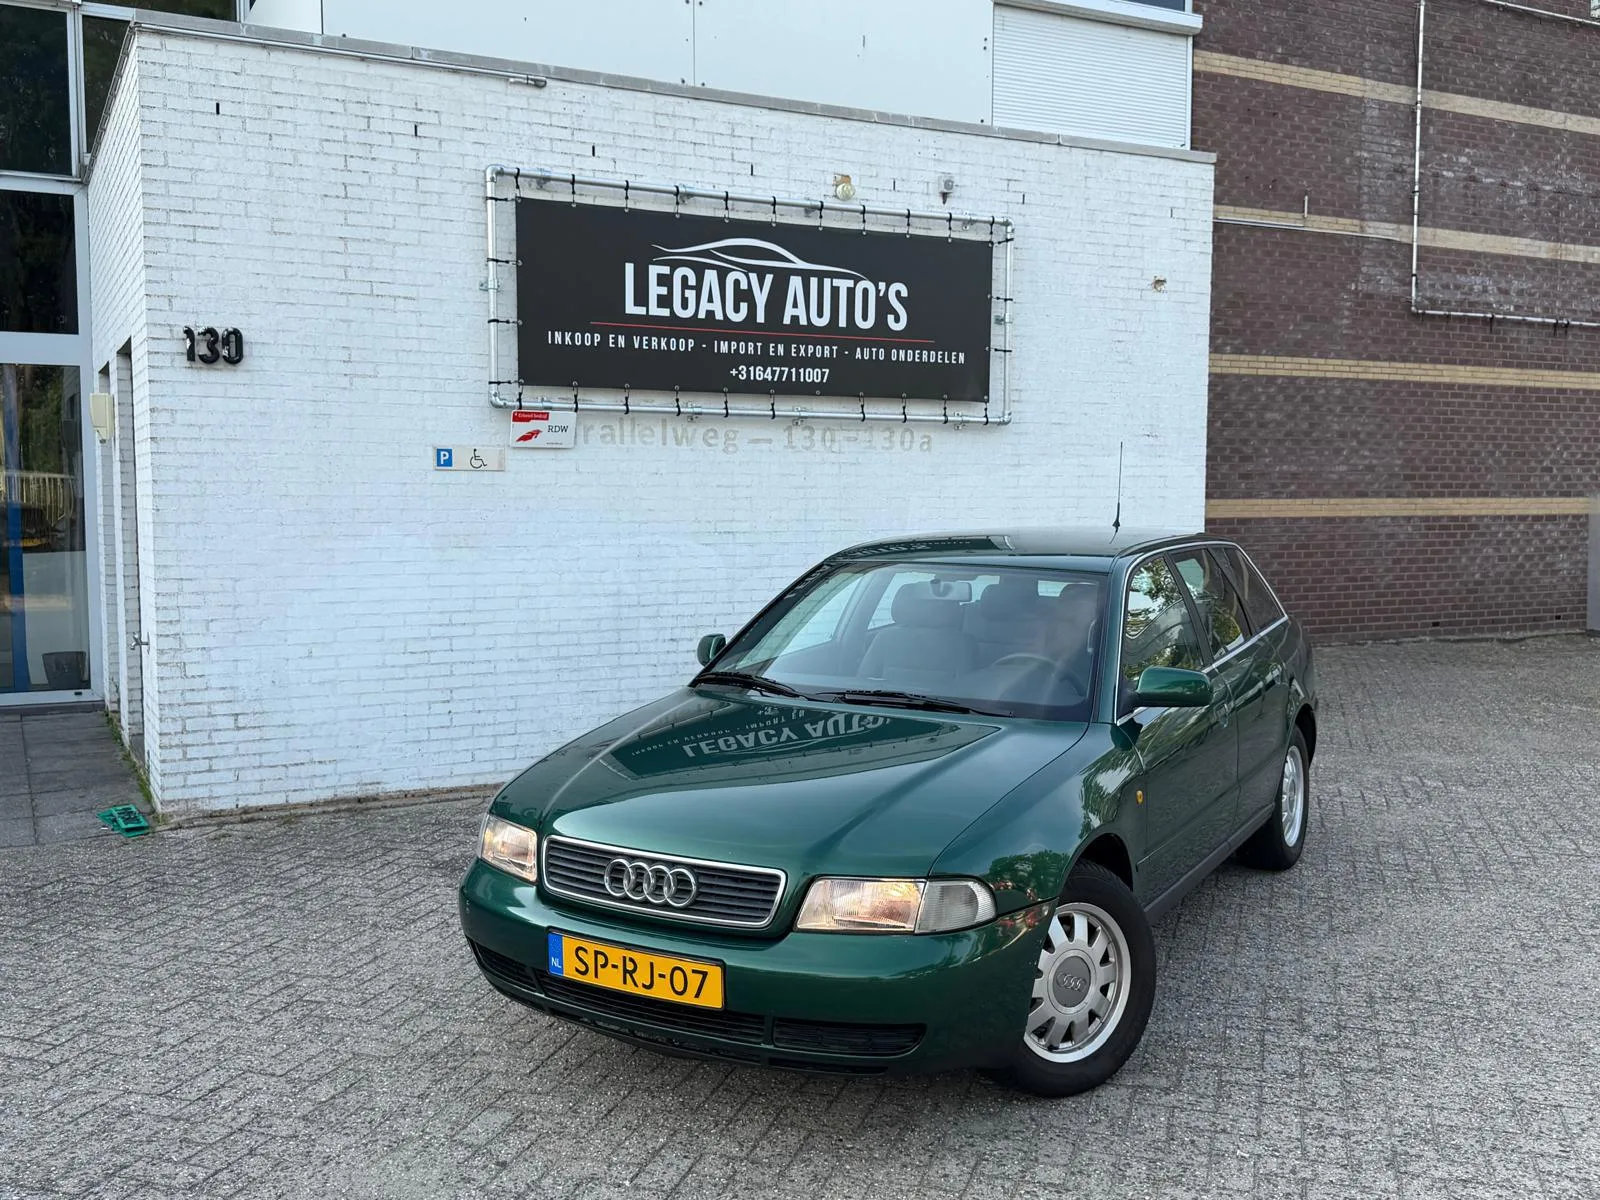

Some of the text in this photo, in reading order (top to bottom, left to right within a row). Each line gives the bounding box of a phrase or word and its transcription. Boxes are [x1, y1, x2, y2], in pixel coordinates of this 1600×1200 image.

[624, 262, 909, 332] LEGACY AUTO'S
[182, 325, 244, 365] 130
[547, 330, 601, 347] INKOOP
[608, 334, 625, 349] EN
[632, 335, 695, 352] VERKOOP
[714, 340, 763, 355] IMPORT
[769, 343, 784, 357] EN
[791, 343, 838, 359] EXPORT
[855, 346, 885, 361] AUTO
[891, 348, 965, 365] ONDERDELEN
[729, 364, 830, 383] +31647711007
[547, 424, 569, 433] RDW
[582, 416, 740, 455] rallelweg
[439, 450, 450, 465] P
[551, 956, 562, 969] NL
[574, 945, 709, 999] SP-RJ-07
